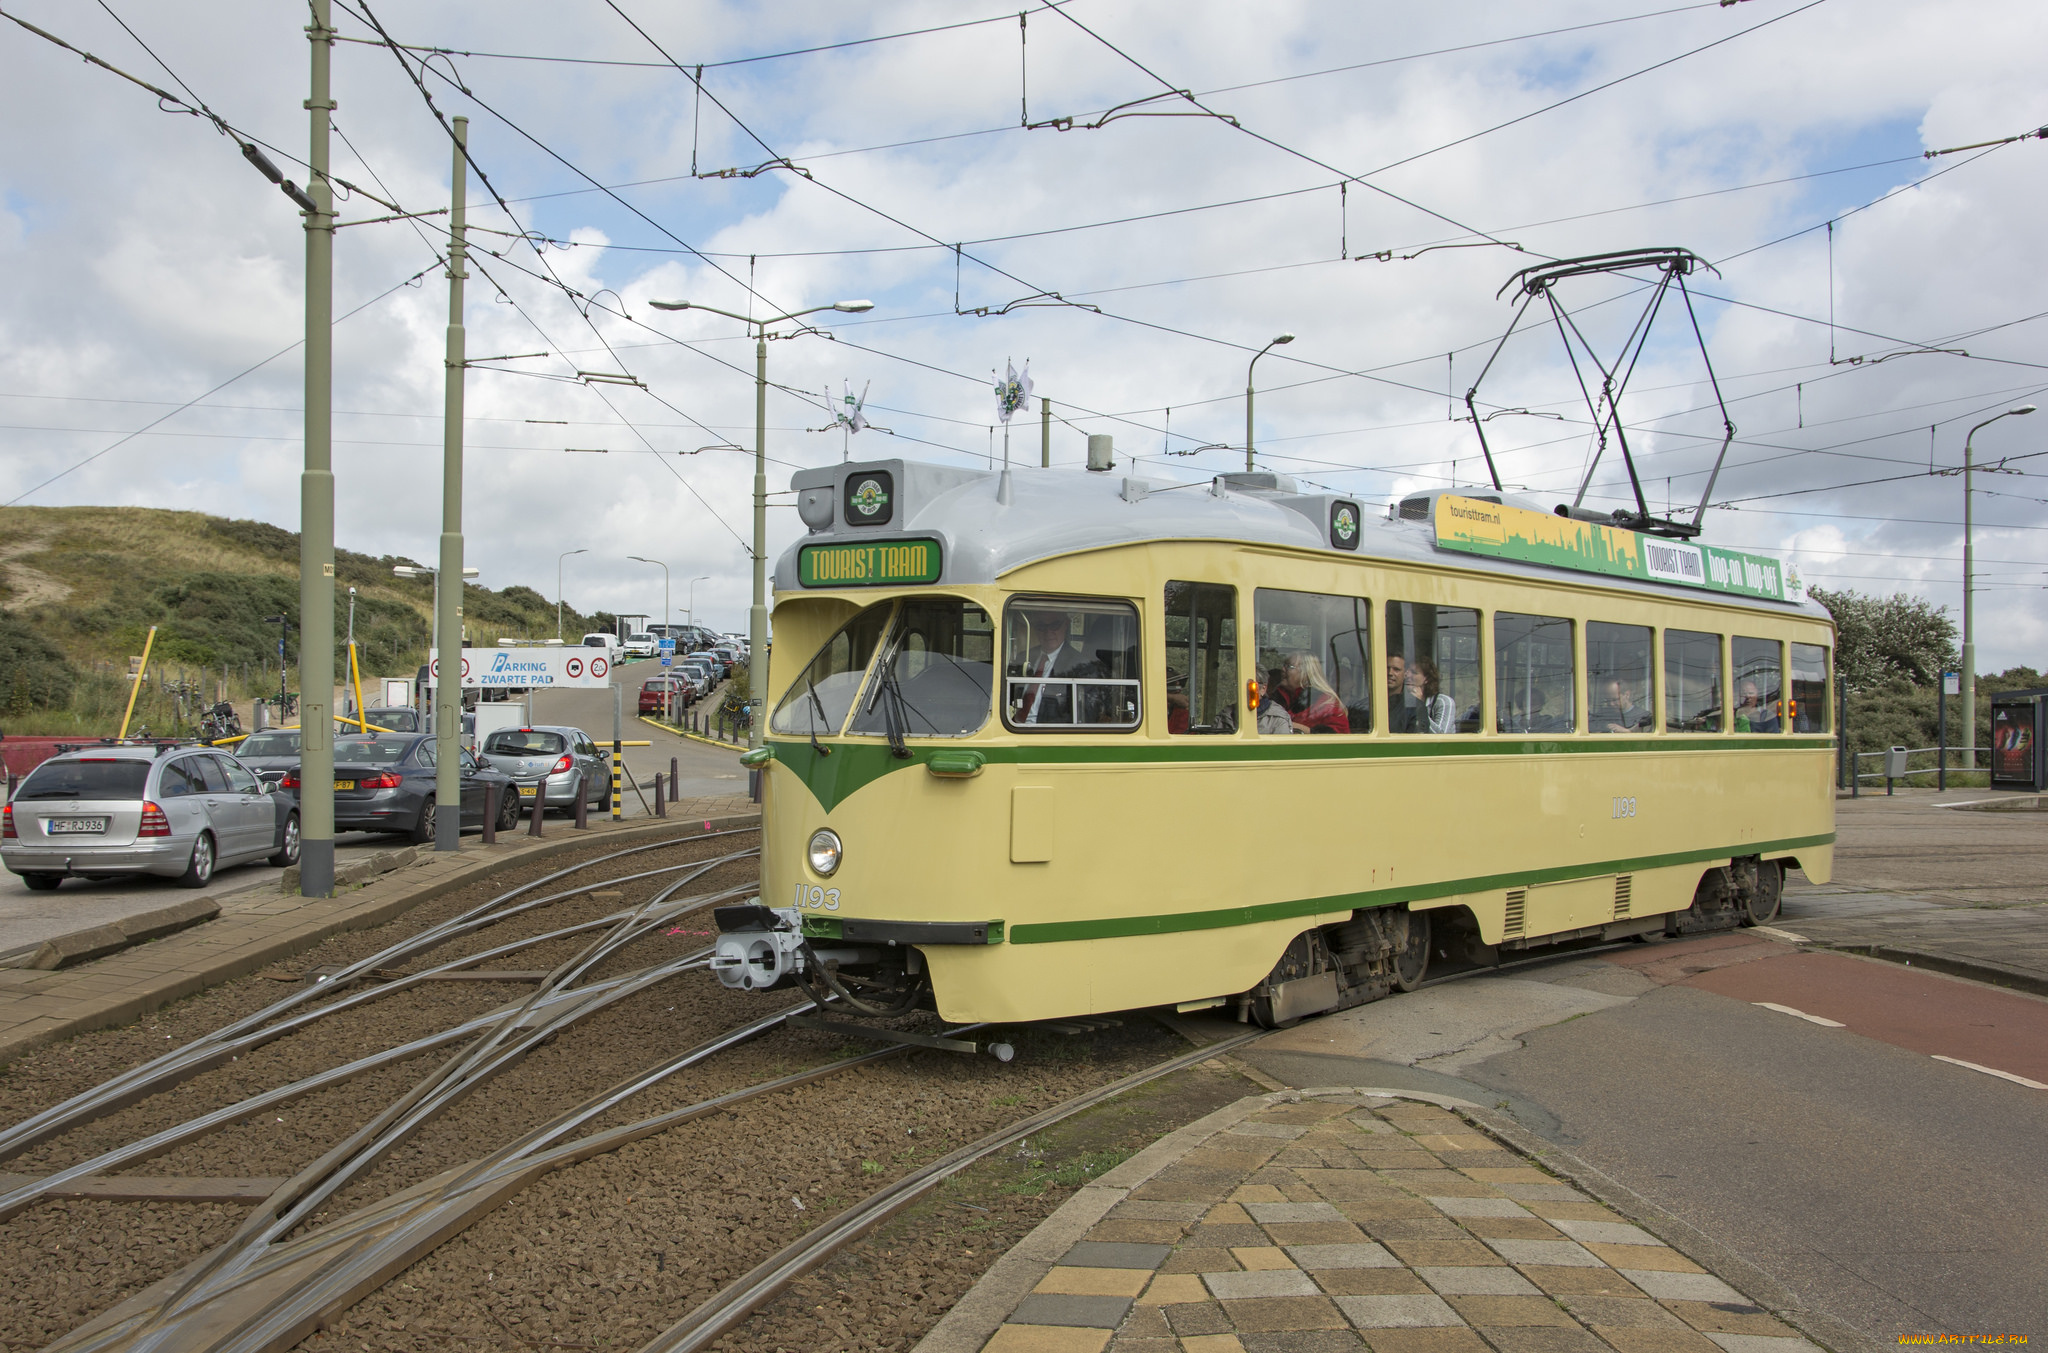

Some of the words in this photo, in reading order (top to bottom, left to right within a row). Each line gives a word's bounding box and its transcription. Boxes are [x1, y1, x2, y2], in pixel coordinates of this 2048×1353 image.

[1450, 504, 1501, 525] touristtram.nl
[811, 548, 875, 580] TOURIST
[879, 546, 927, 577] TRAM
[1647, 545, 1679, 574] TOURIST
[1678, 550, 1701, 577] TRAM
[1708, 549, 1743, 588] hop-on
[1744, 556, 1778, 596] hop-off
[490, 652, 547, 672] PARKING
[481, 675, 527, 684] ZWARTE
[531, 675, 552, 684] PAD
[1611, 796, 1637, 819] 1193
[792, 883, 842, 911] 1193
